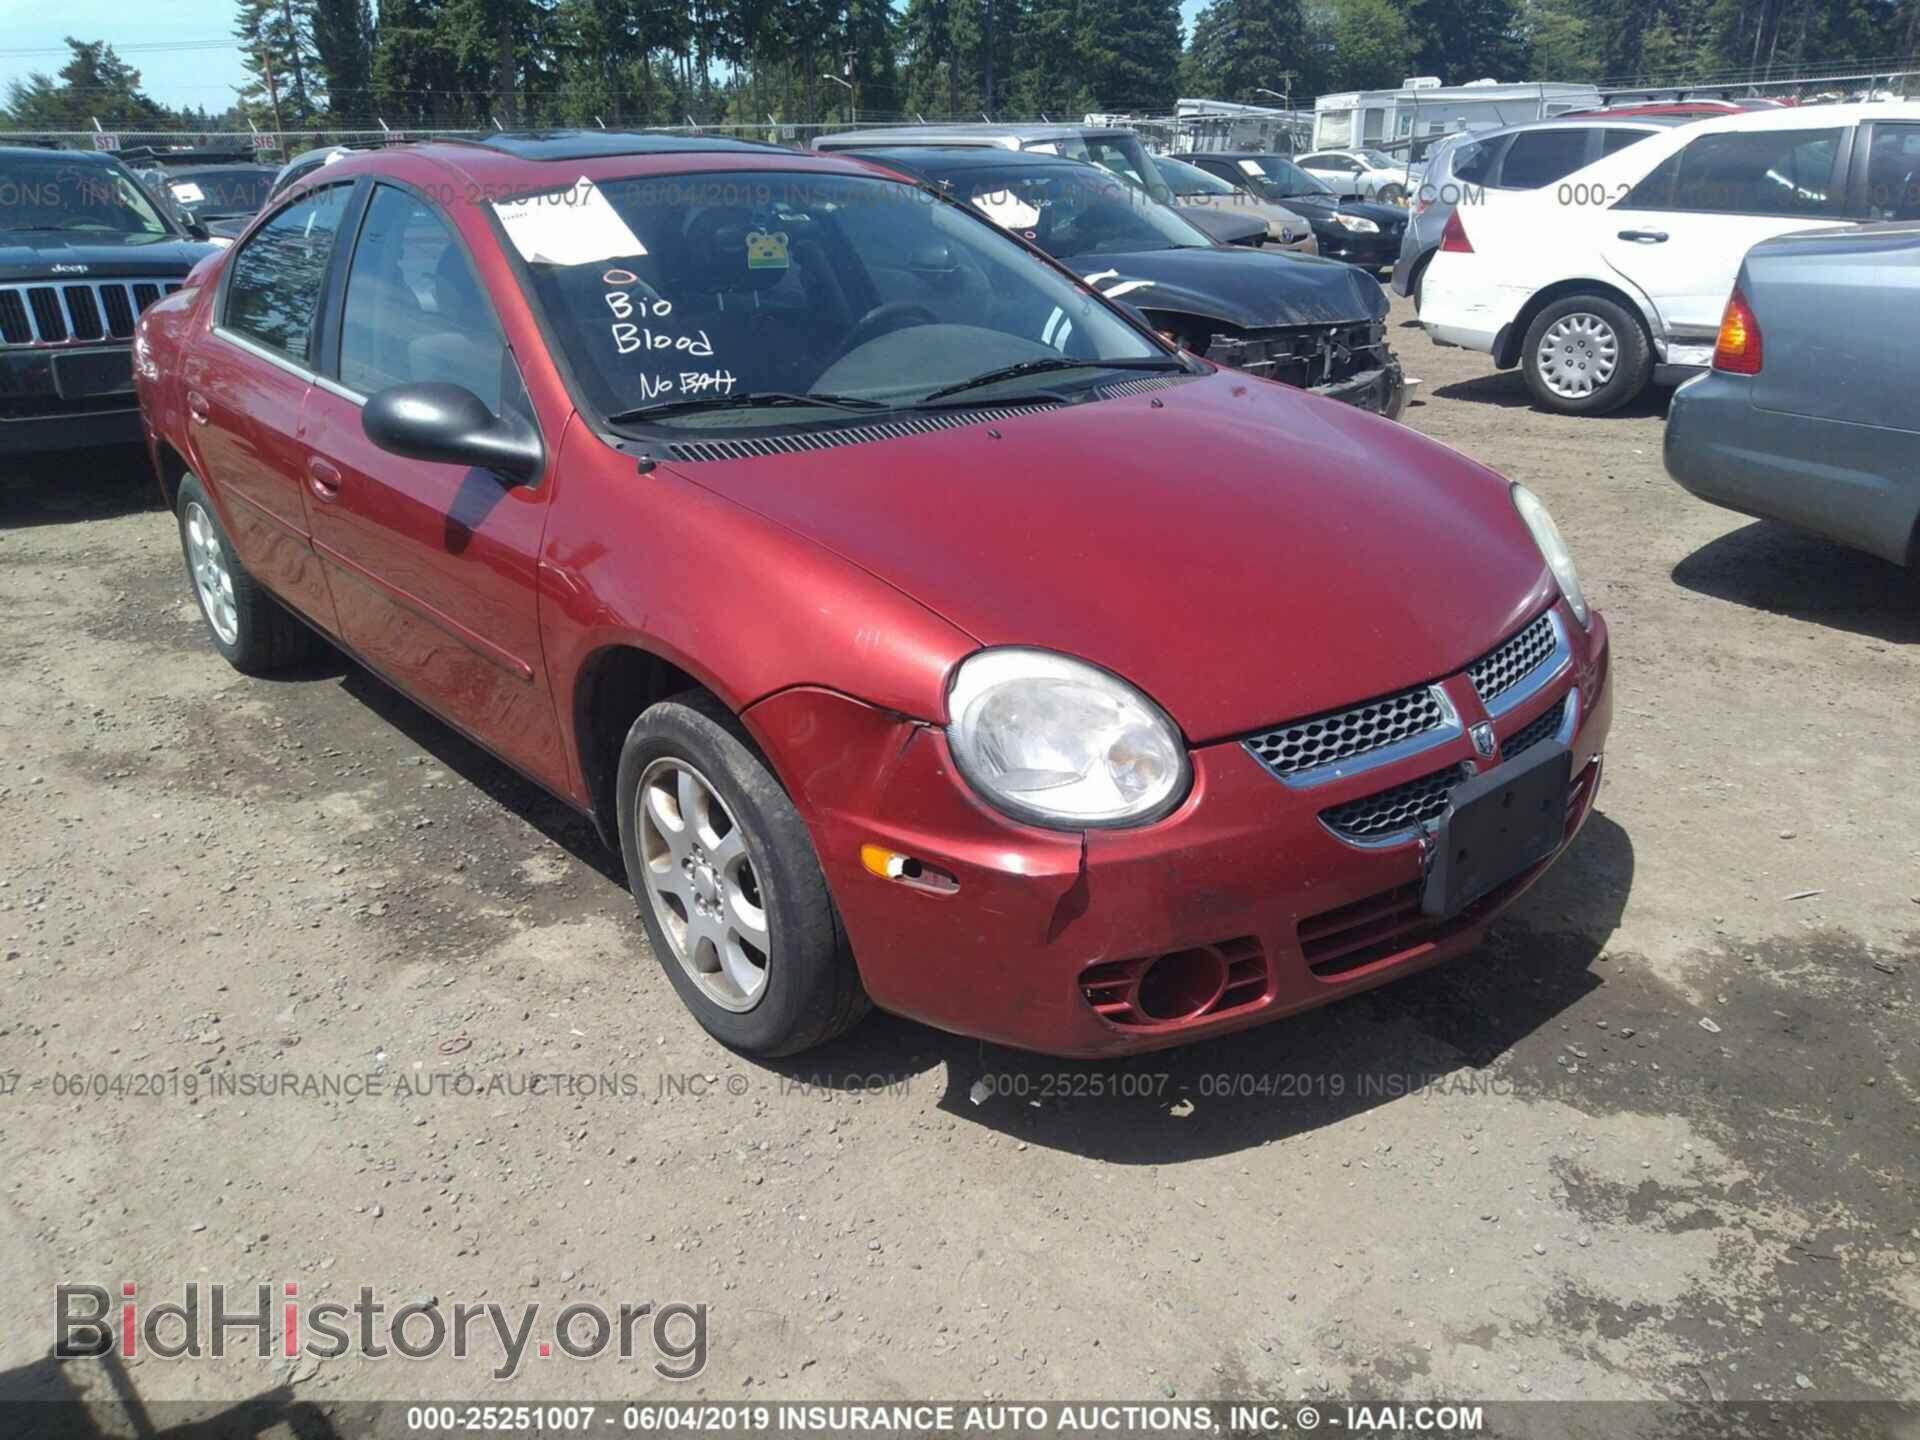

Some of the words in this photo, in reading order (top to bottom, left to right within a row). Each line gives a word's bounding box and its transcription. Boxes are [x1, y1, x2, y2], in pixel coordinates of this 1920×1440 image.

[51, 263, 88, 274] Jeep
[605, 292, 671, 319] Bio
[612, 323, 714, 355] Blood
[640, 373, 672, 399] No
